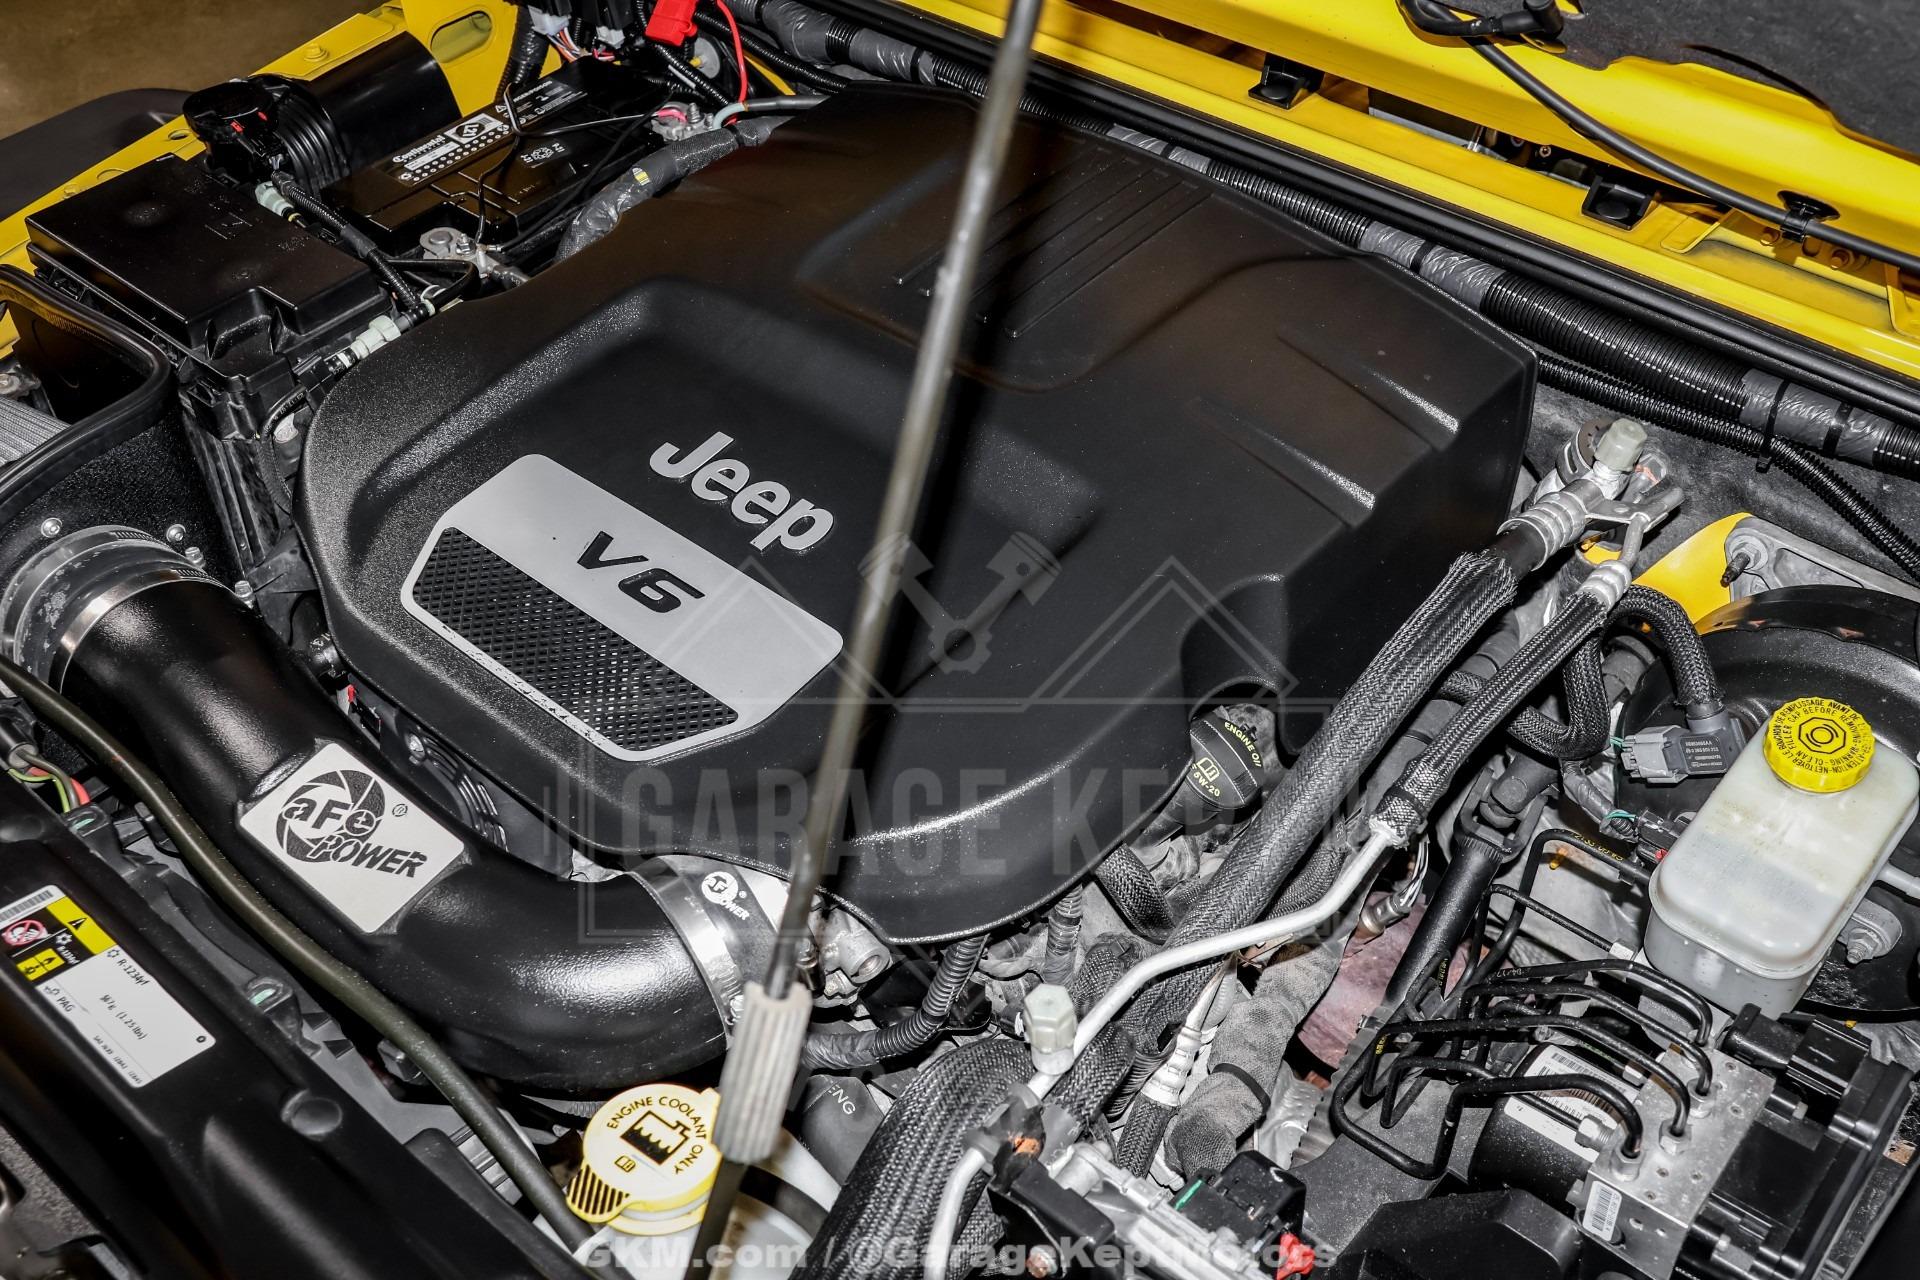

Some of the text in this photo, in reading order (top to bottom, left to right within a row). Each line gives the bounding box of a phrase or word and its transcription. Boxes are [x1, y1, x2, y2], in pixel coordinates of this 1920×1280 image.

[393, 134, 446, 163] Continental
[649, 431, 834, 551] Jeep
[576, 530, 706, 613] V6
[1780, 699, 1825, 718] REMPLISSAGE
[1828, 701, 1850, 714] AVANT
[1787, 711, 1801, 723] CAP
[1802, 706, 1838, 717] BEFORE
[1224, 721, 1255, 752] ENGINE
[1783, 724, 1797, 750] FILLER
[282, 797, 377, 837] aFe
[307, 834, 428, 878] POWER
[117, 958, 150, 987] R-1234yf
[57, 996, 75, 1013] PAG
[606, 1096, 707, 1175] ENGINE COOLANT ONLY
